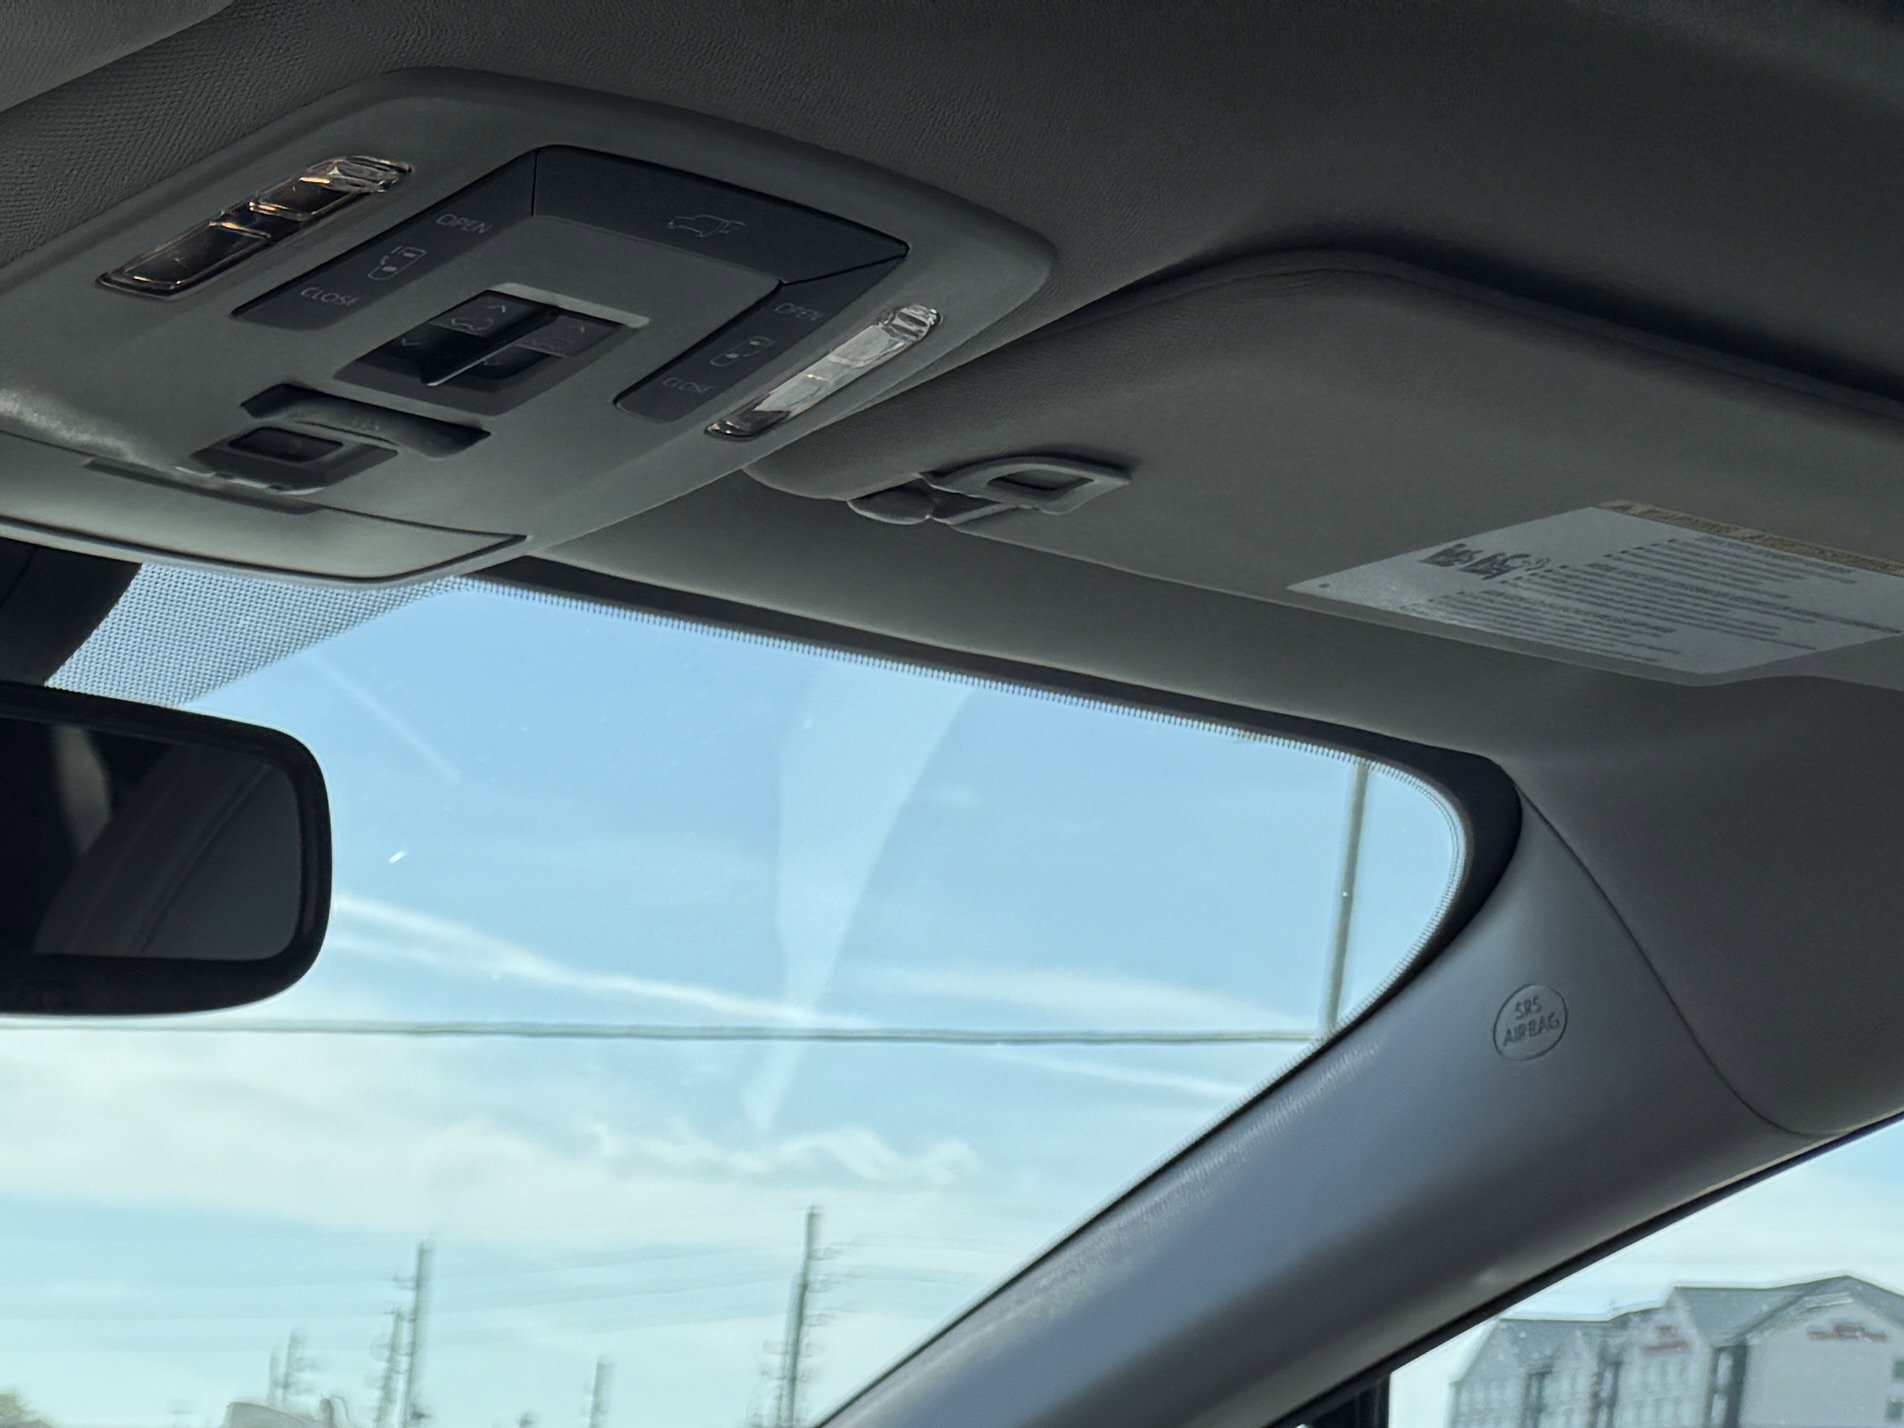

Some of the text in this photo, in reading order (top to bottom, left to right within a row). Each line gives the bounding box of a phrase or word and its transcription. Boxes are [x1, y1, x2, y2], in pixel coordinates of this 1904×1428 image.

[436, 213, 491, 234] OPEN
[1515, 996, 1542, 1020] SRS
[1502, 1011, 1560, 1047] AIRBAG
